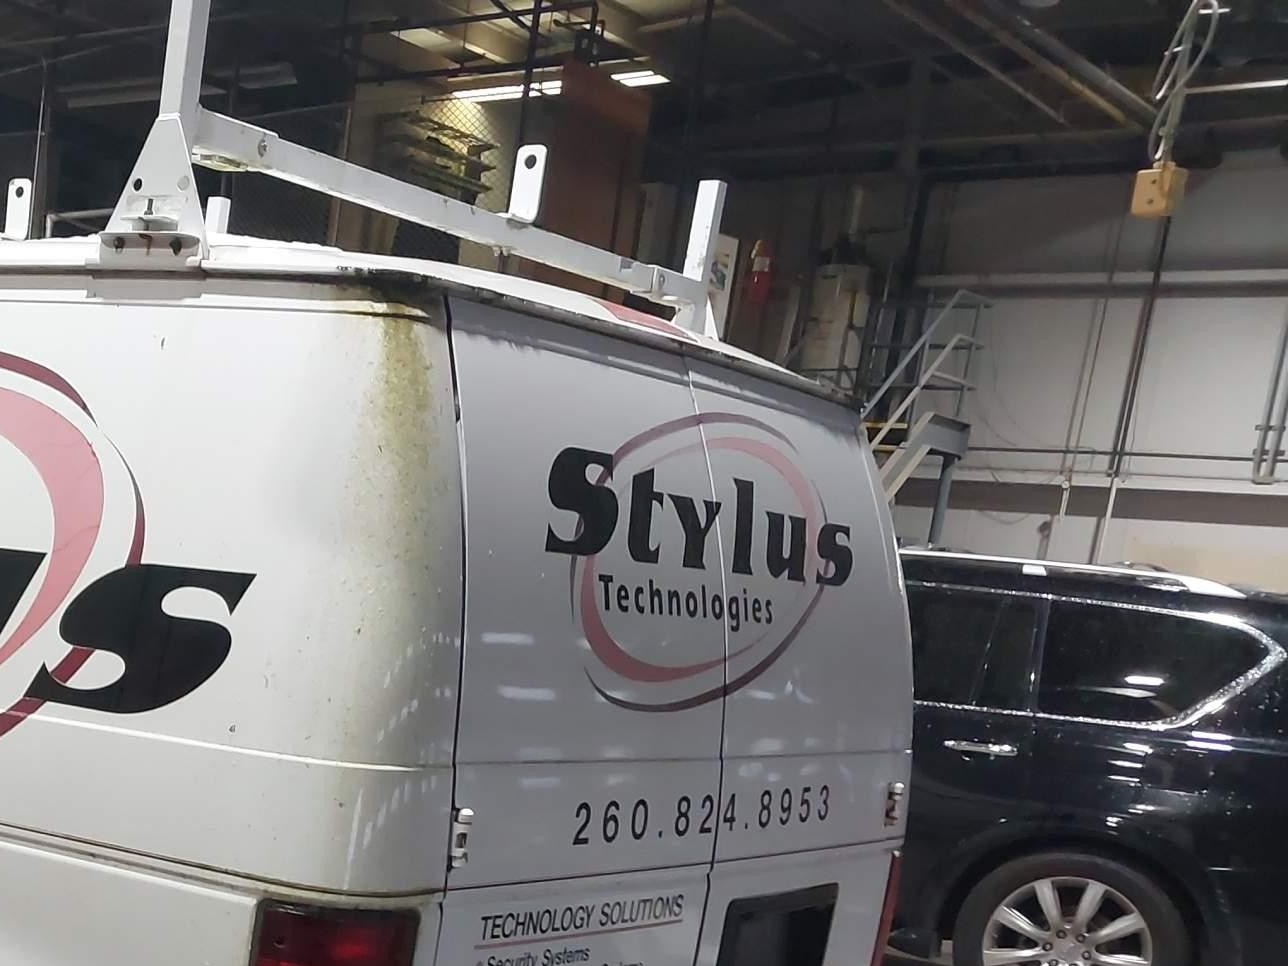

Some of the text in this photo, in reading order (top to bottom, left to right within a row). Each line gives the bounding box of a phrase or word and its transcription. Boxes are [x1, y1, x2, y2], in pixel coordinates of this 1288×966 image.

[545, 446, 853, 586] Stylus
[599, 574, 773, 632] Technologies
[573, 785, 830, 846] 260.824.8953
[481, 894, 684, 940] TECHNOLOGY SOLUTIONS
